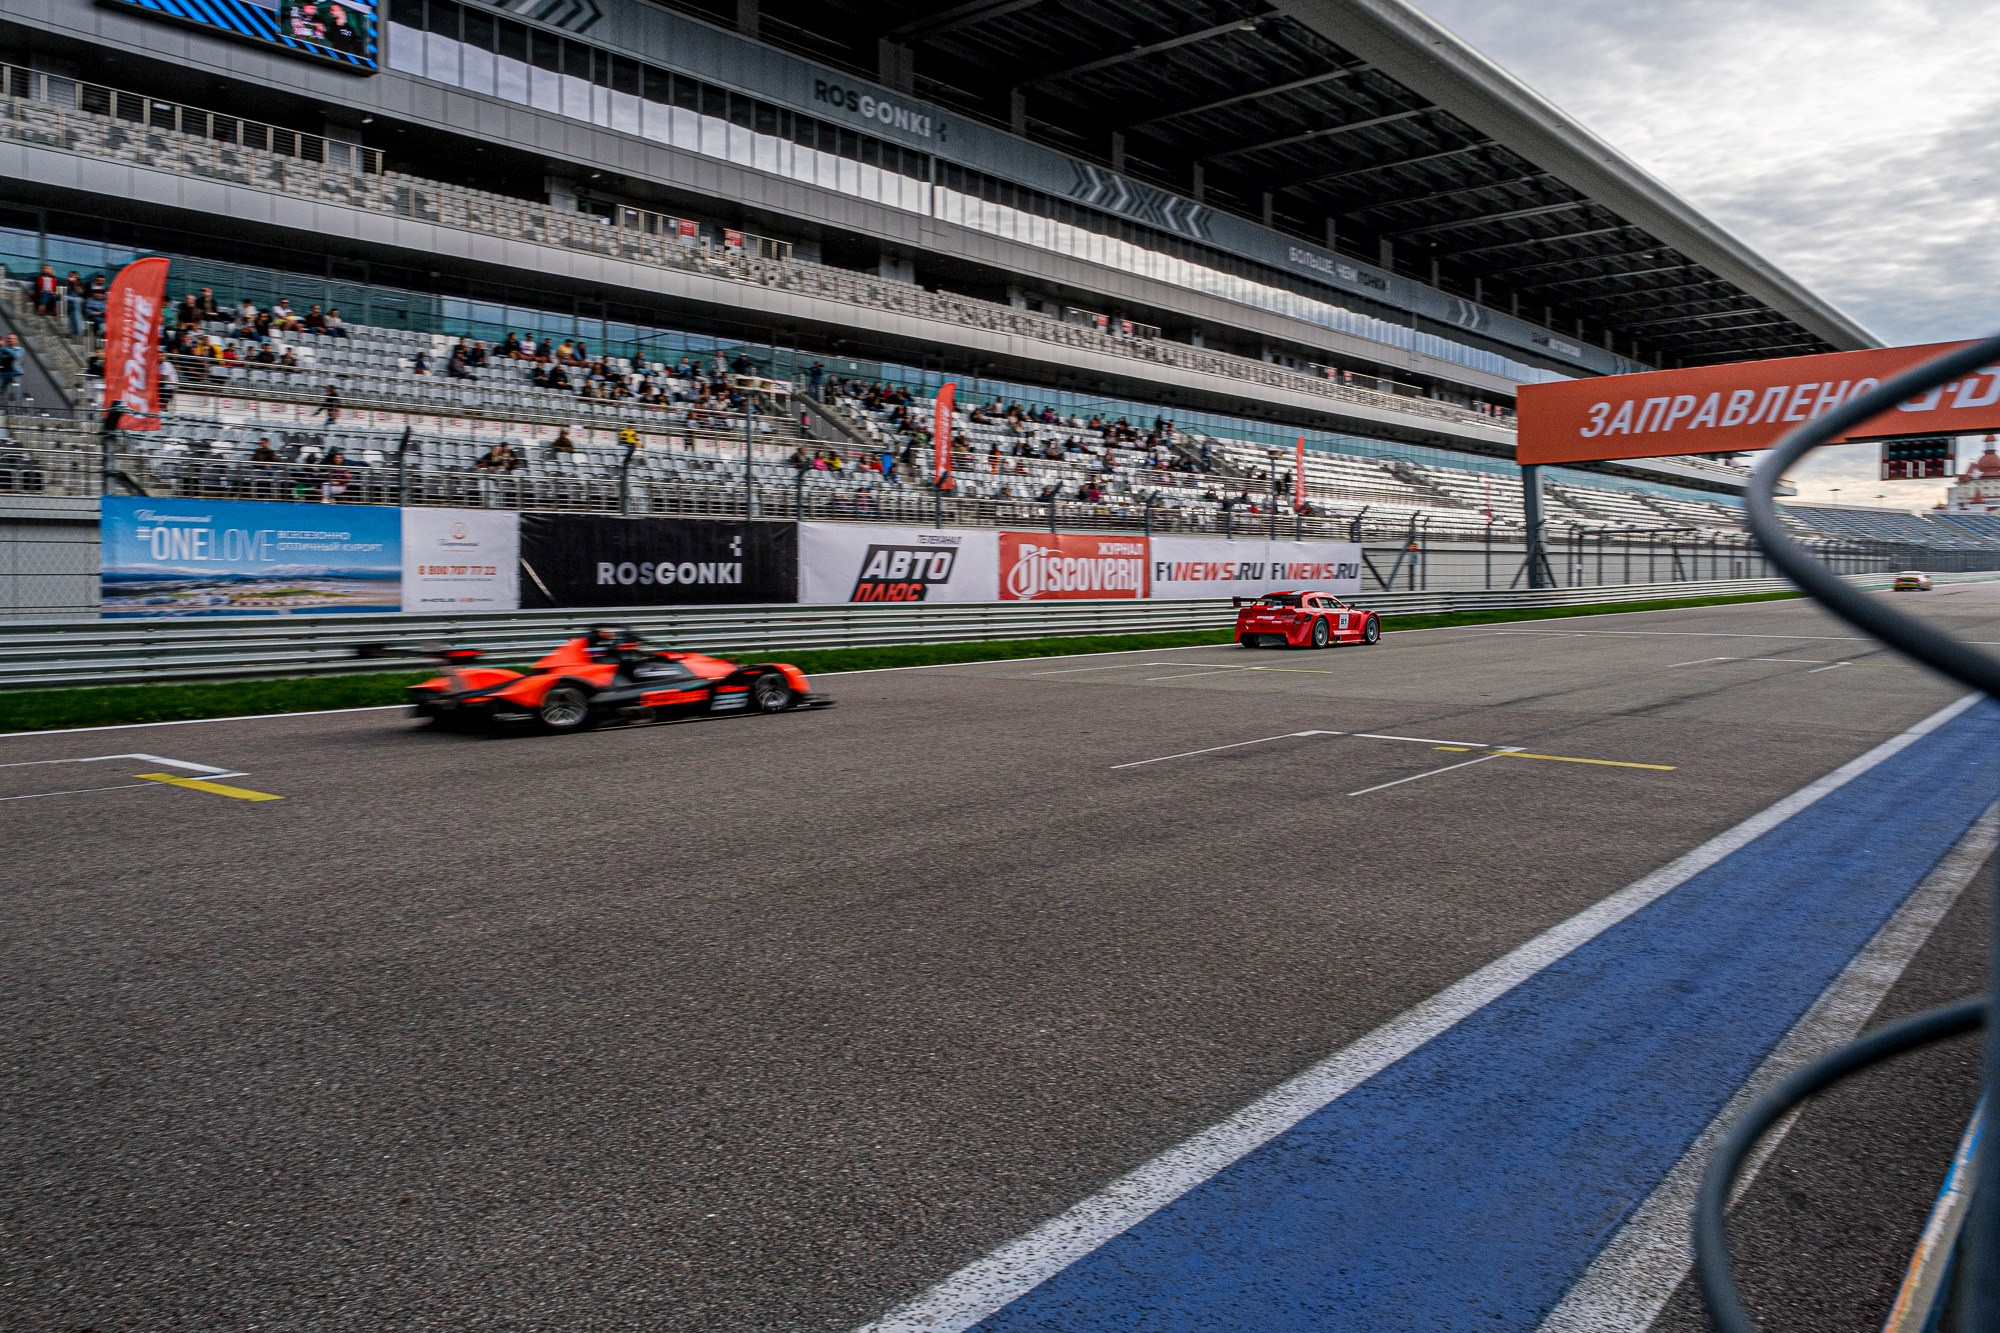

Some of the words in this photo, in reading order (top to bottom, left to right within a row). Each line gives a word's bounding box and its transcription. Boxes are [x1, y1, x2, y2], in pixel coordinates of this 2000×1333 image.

[814, 79, 931, 138] ROSGONKI
[596, 562, 742, 585] ROSGONKI
[861, 551, 953, 580] АВТО
[1155, 562, 1264, 581] F1NEWS.RU
[1271, 562, 1360, 580] F1NEWS.RU
[853, 583, 923, 602] ПЛЮС
